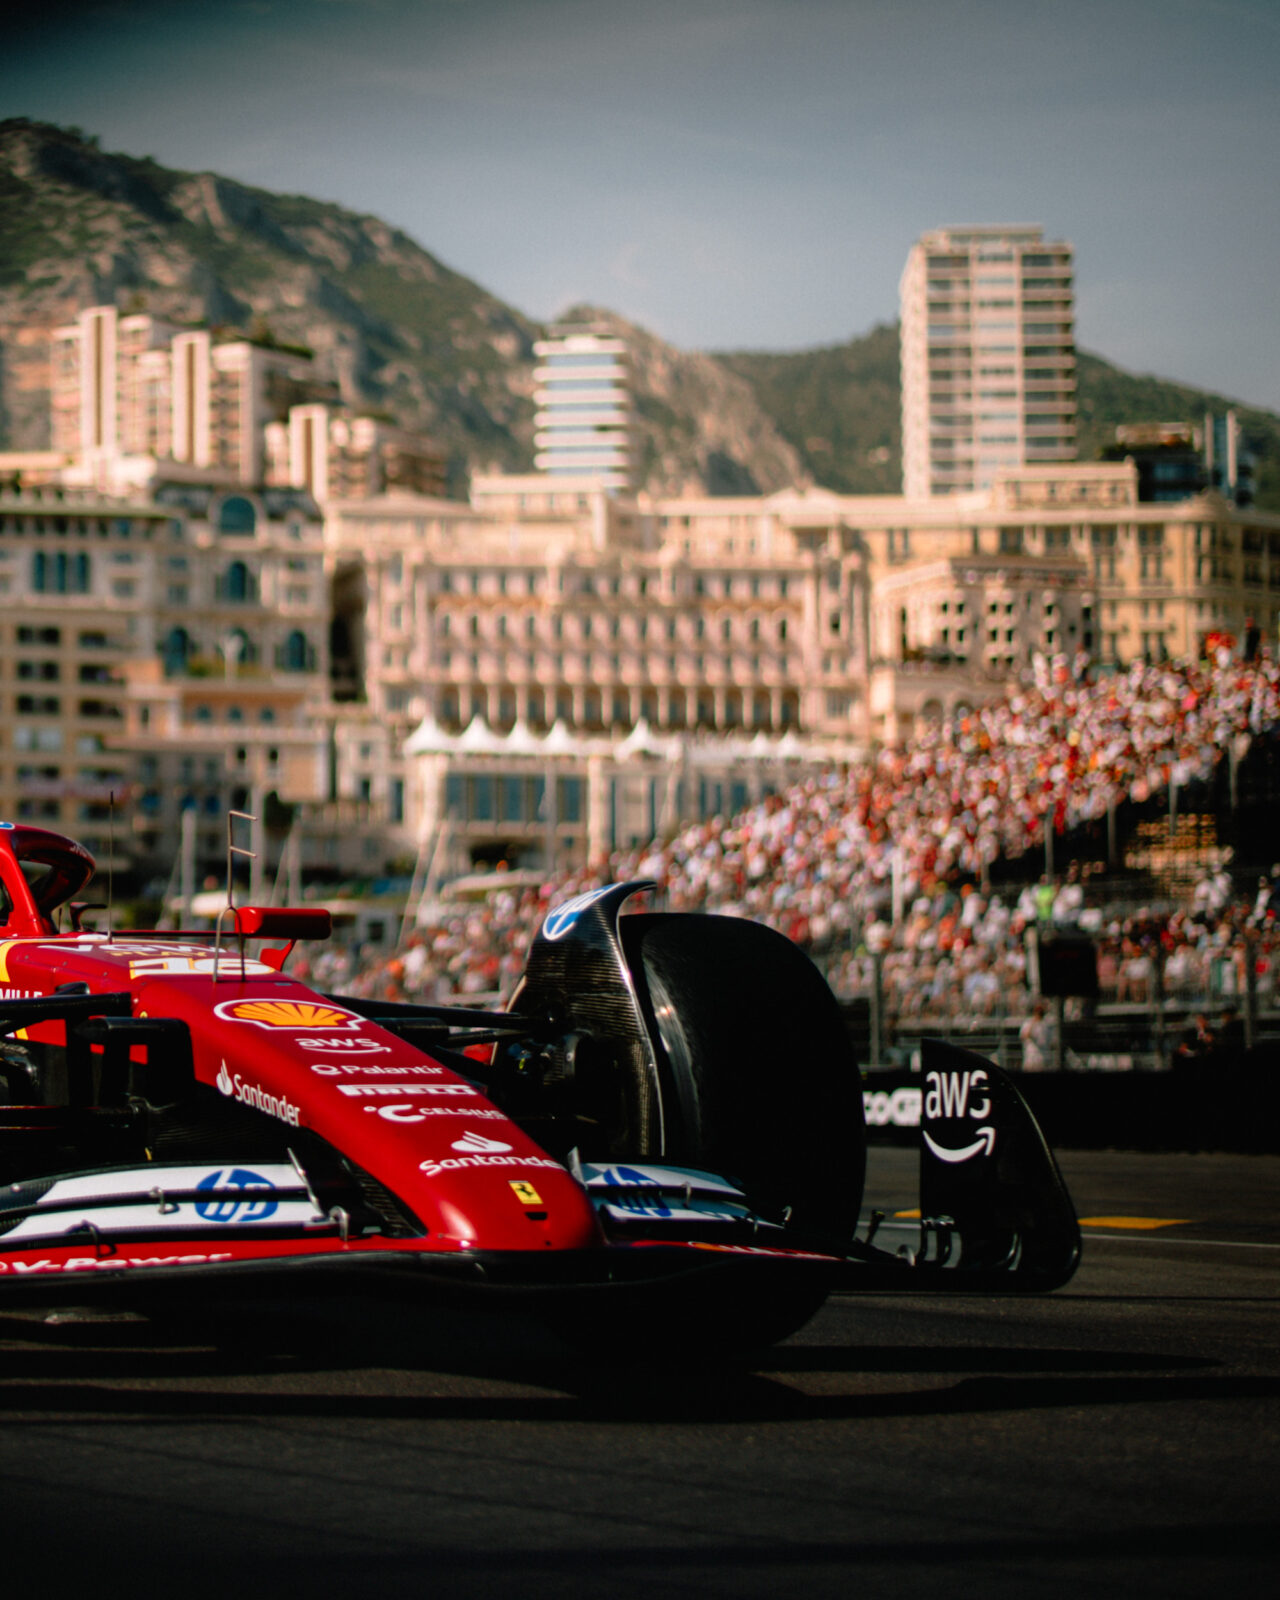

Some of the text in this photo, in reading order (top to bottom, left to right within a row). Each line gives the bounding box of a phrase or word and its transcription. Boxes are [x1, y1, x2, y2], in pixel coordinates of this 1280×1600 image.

[129, 958, 276, 980] 16
[340, 1064, 444, 1076] Palantir
[233, 1073, 301, 1128] Santander
[336, 1083, 478, 1098] PIRELLI
[924, 1069, 992, 1120] aws
[418, 1106, 509, 1121] CELSIUS
[196, 1169, 278, 1223] hp
[10, 1252, 233, 1274] V-Power
